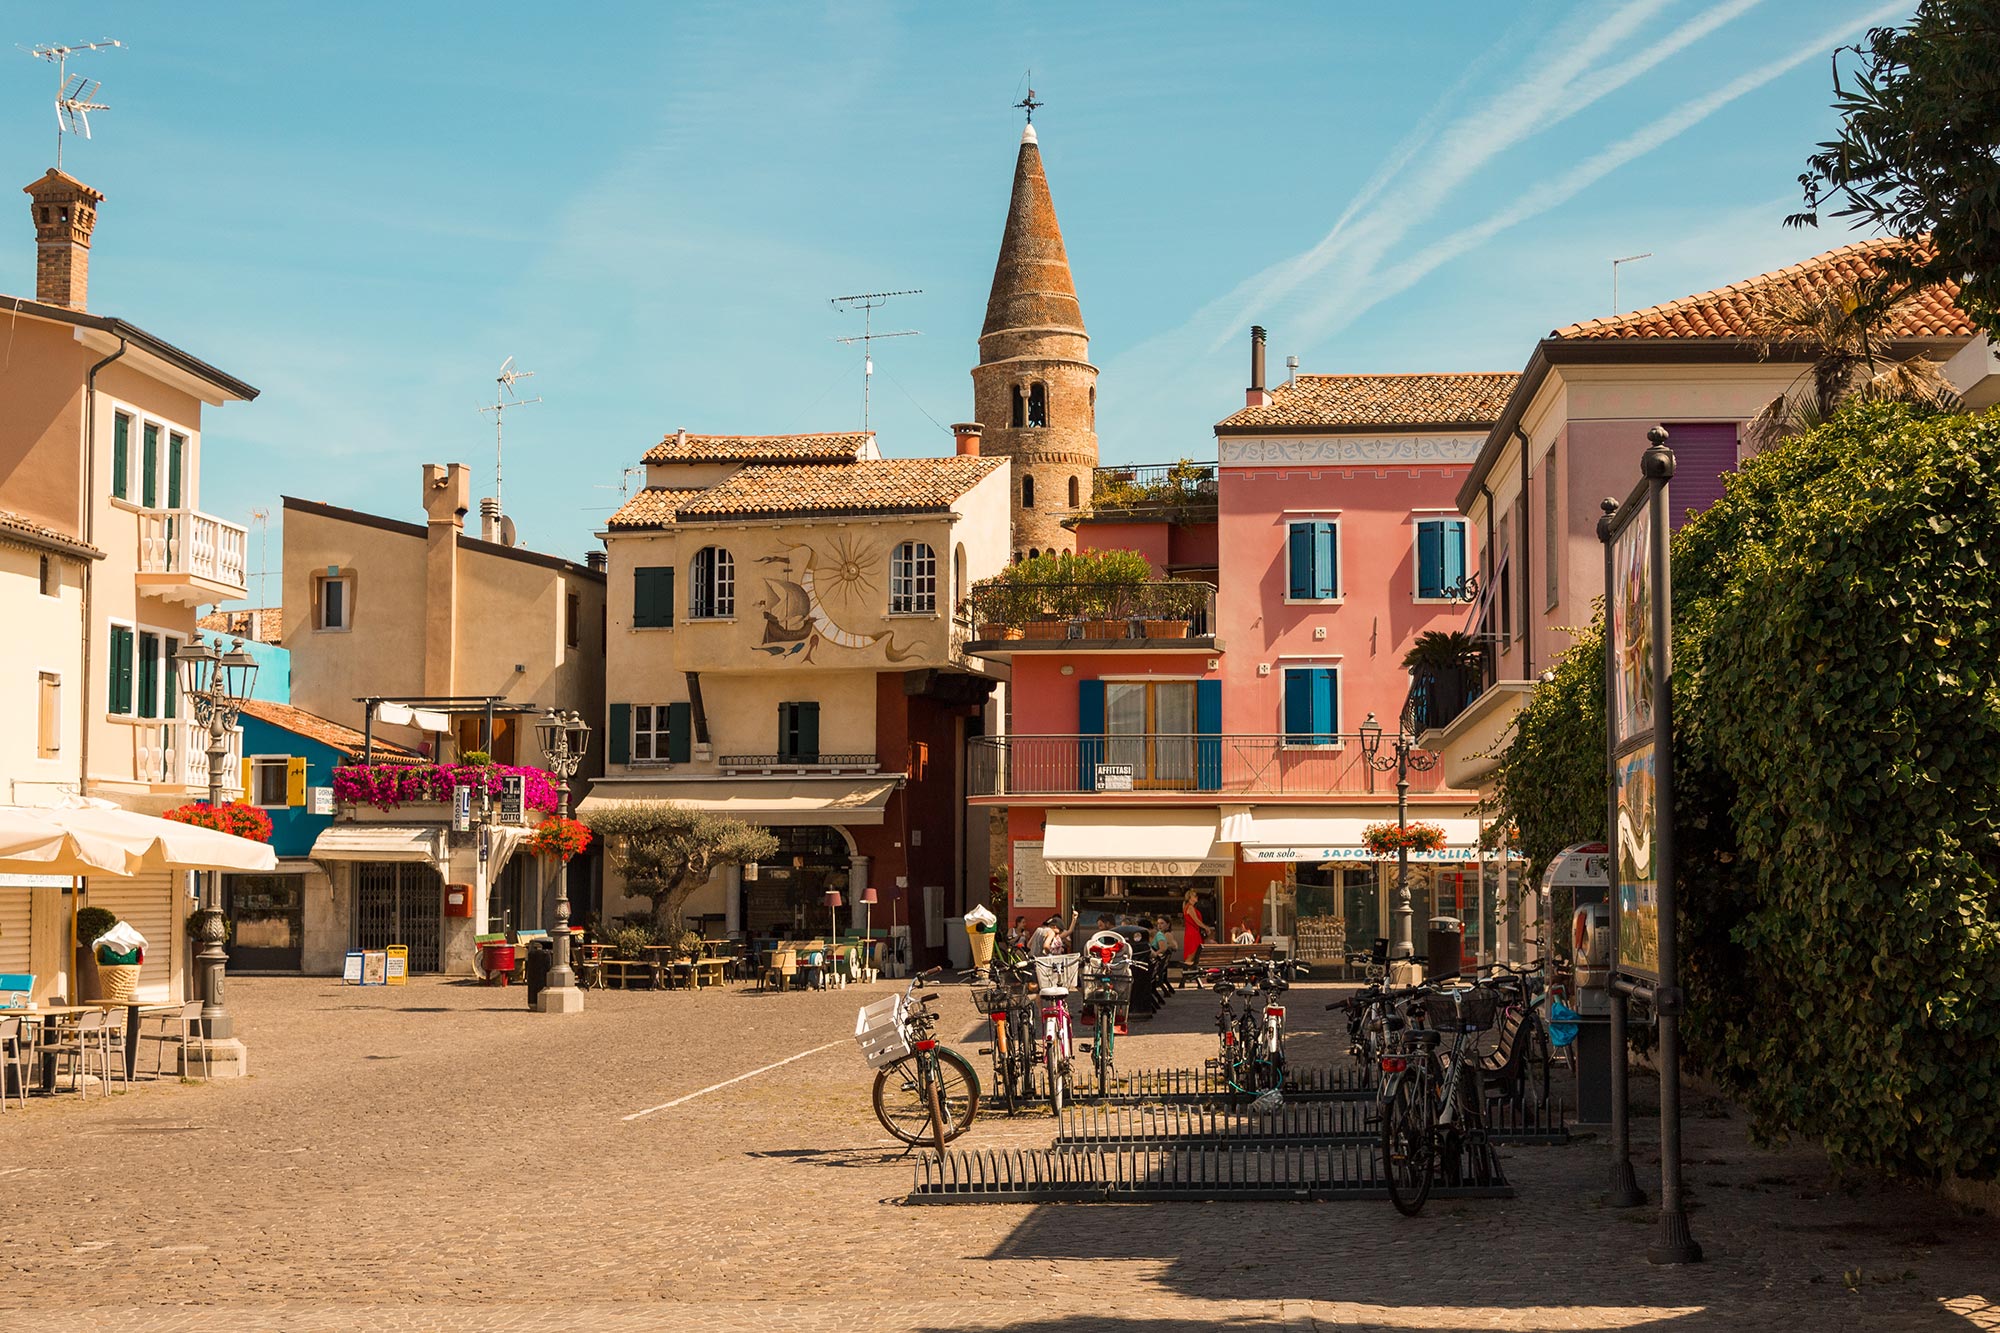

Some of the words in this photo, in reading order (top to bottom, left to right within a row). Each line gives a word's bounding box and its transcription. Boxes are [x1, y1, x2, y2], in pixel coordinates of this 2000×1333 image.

[1098, 766, 1131, 775] AFFITTASI
[501, 813, 520, 821] LOTTO
[1416, 849, 1471, 859] PUGLIA
[1065, 861, 1117, 874] MISTER
[1122, 861, 1179, 874] GELATO
